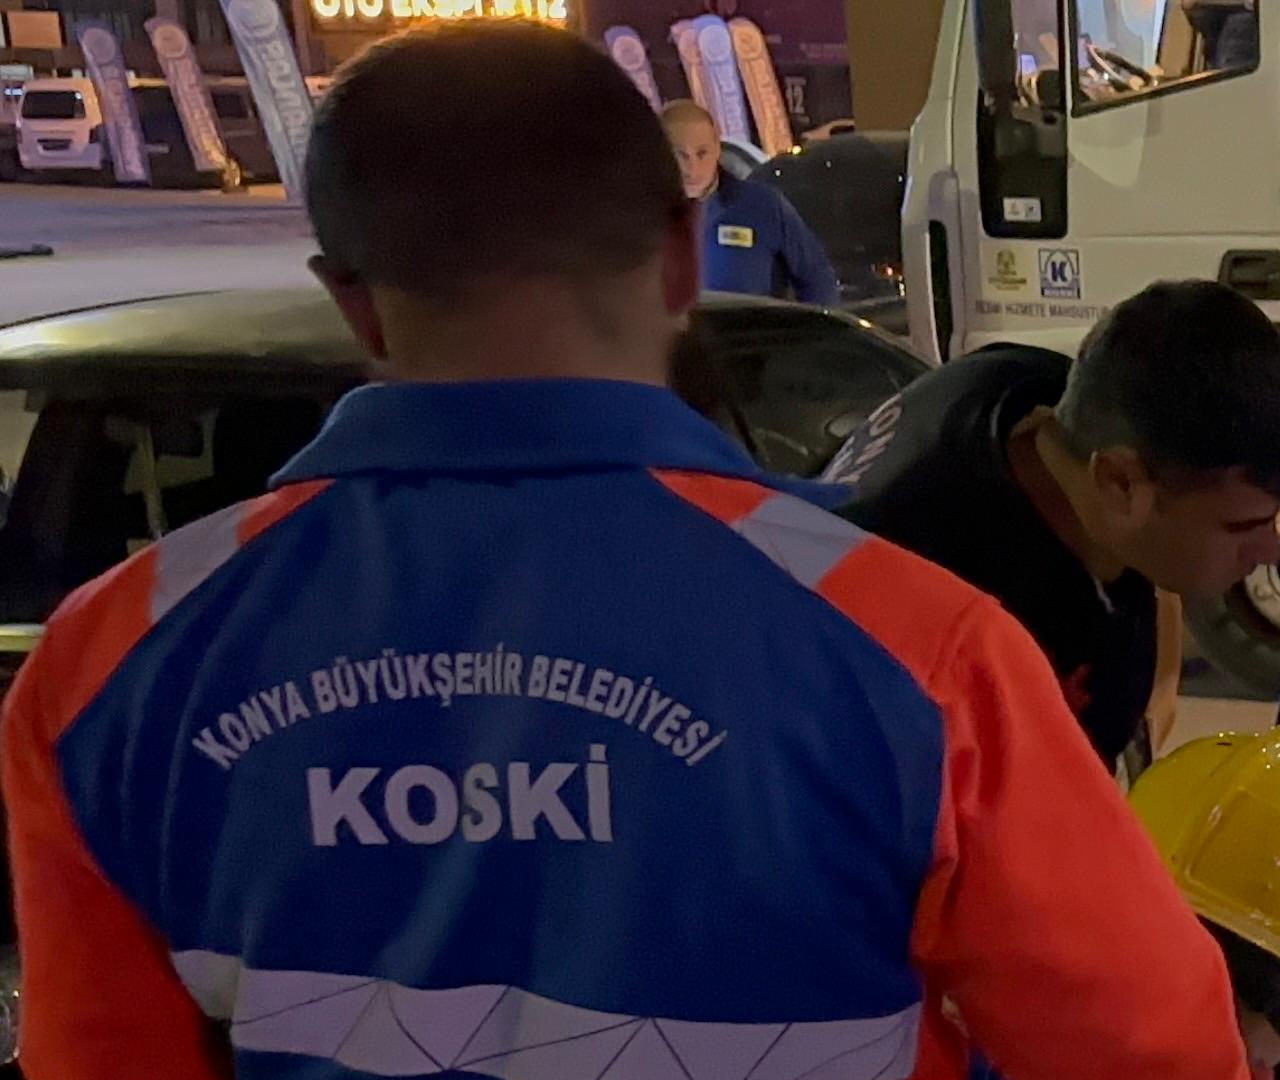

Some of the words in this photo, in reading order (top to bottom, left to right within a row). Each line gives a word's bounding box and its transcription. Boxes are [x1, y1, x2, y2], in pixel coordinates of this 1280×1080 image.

[192, 680, 311, 771] KONYA
[310, 641, 524, 708] BÜYÜKŞEHİR
[307, 743, 613, 848] KOSKİ
